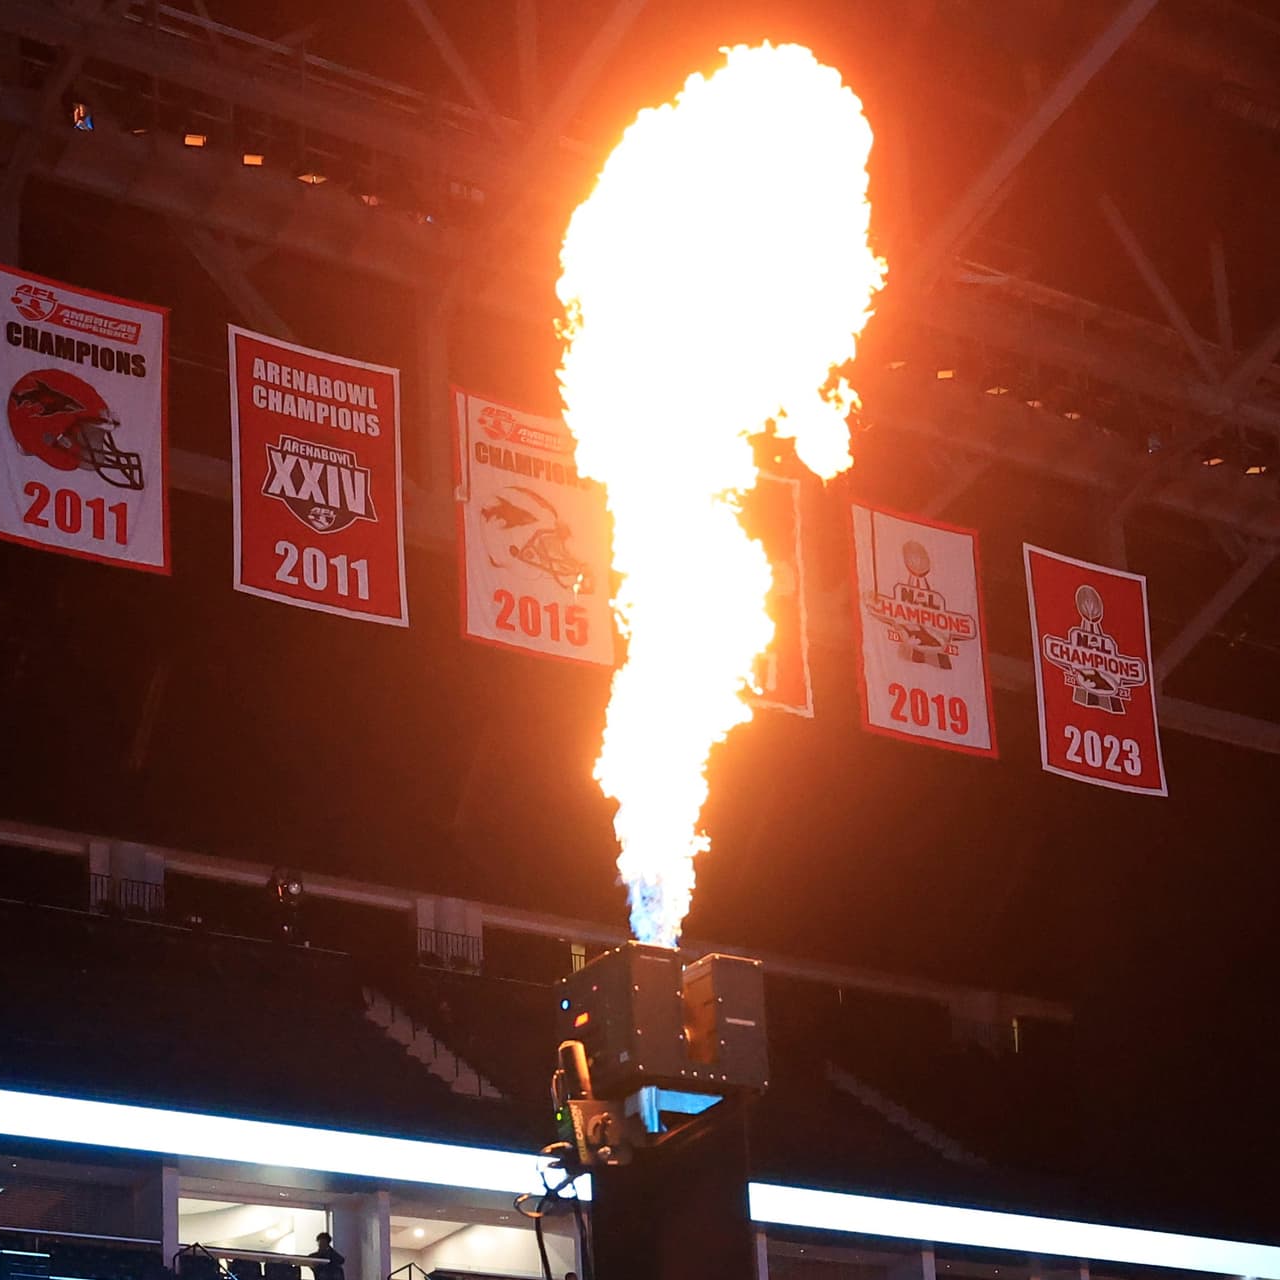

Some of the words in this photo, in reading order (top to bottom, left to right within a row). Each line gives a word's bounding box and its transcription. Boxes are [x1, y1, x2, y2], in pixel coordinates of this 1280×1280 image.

[6, 321, 146, 378] CHAMPIONS
[253, 358, 377, 409] ARENABOWL
[253, 384, 380, 437] CHAMPIONS
[283, 440, 353, 468] ARENABOWL
[475, 441, 592, 491] CHAMPION
[268, 450, 365, 515] XXIV
[23, 481, 128, 545] 2011
[275, 540, 369, 600] 2011
[494, 589, 589, 647] 2015
[1050, 642, 1139, 678] CHAMPIONS
[889, 683, 969, 735] 2019
[1064, 725, 1141, 776] 2023
